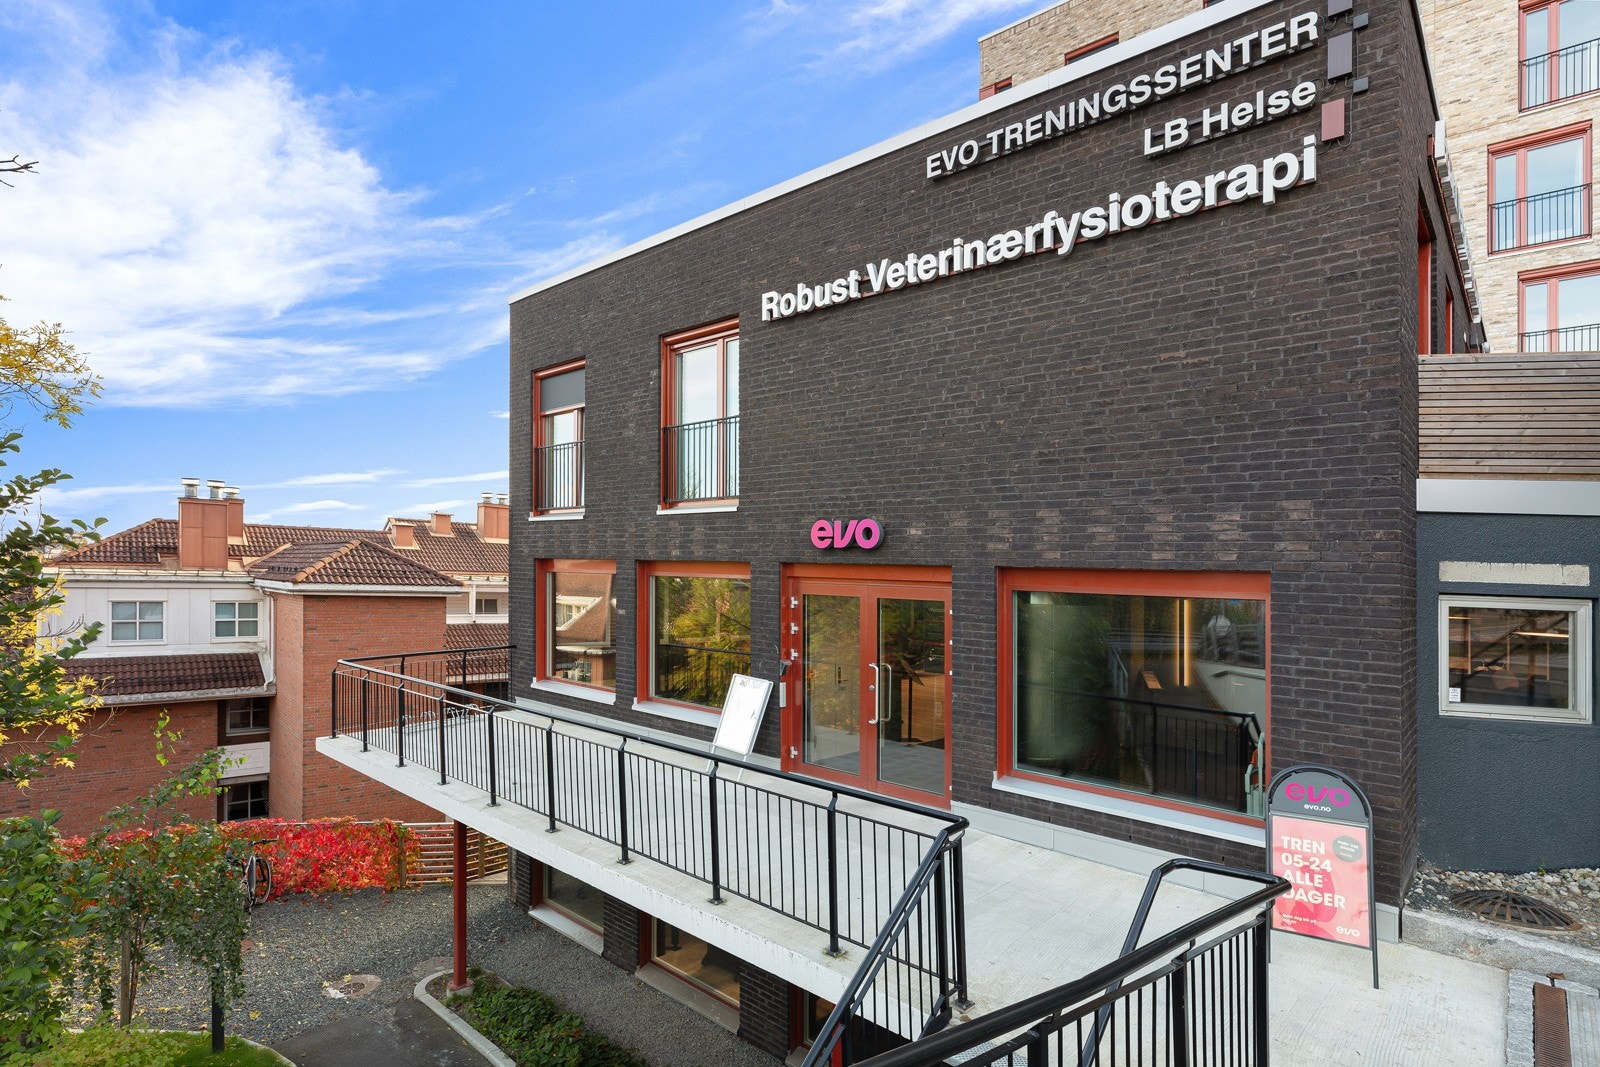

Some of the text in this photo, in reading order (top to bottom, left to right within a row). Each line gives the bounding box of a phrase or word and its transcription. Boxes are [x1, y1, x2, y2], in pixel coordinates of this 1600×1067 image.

[926, 11, 1318, 179] EVO TRENINGSSENTER
[1144, 81, 1316, 156] LB Helse
[761, 134, 1317, 322] Robust Veterinærfysioterapi
[810, 518, 881, 549] evo
[1285, 782, 1351, 807] evo
[1304, 803, 1332, 812] evo.no
[1281, 835, 1326, 855] TREN
[1281, 852, 1332, 873] 05-24
[1283, 869, 1323, 888] ALLE
[1335, 925, 1361, 938] evo
